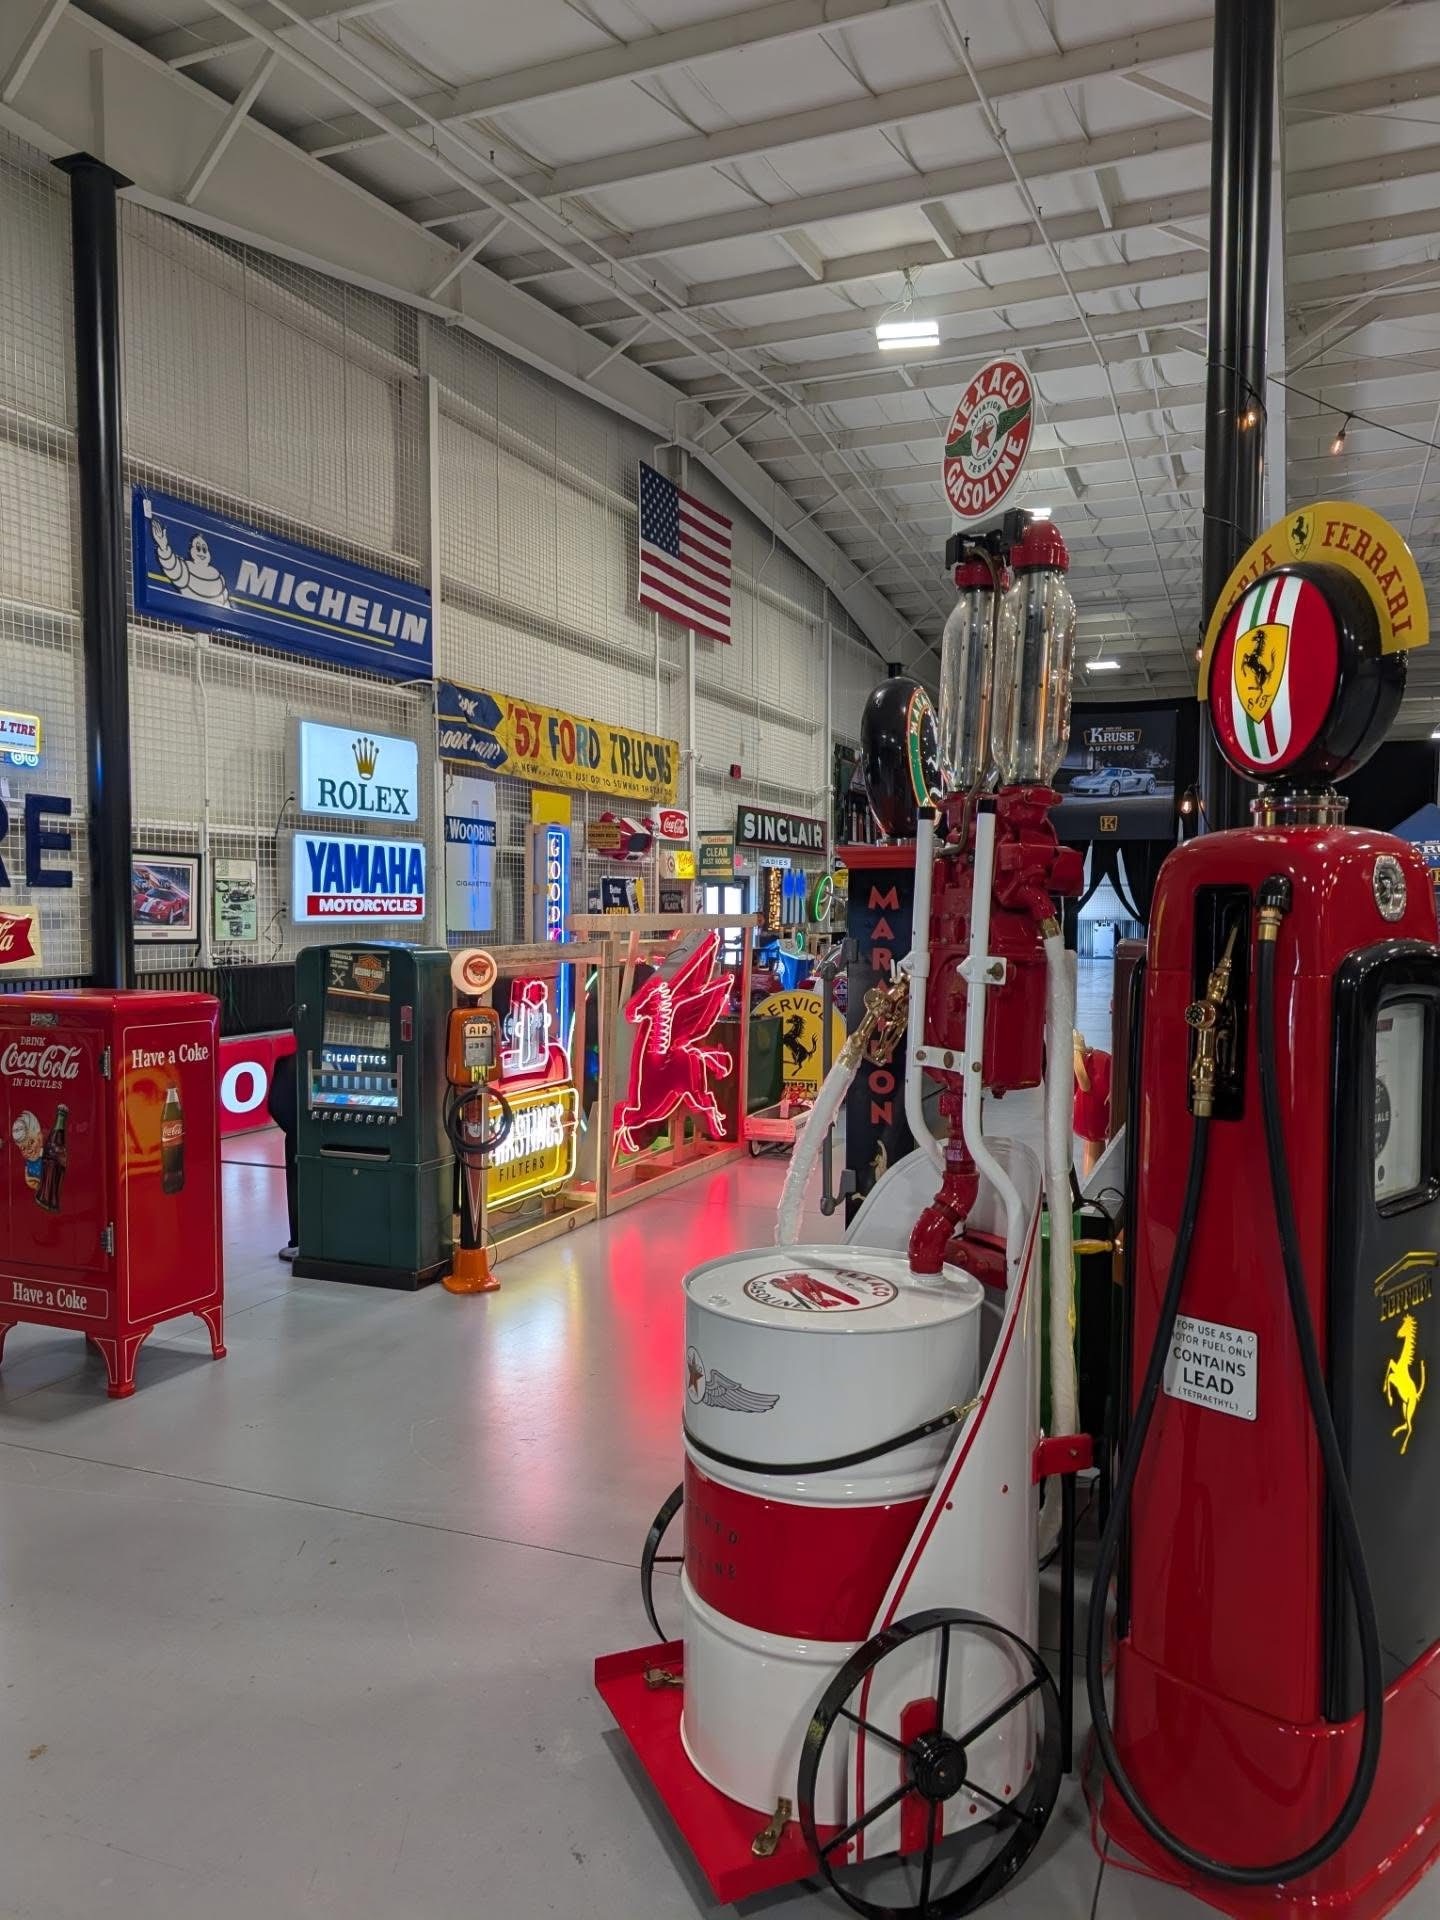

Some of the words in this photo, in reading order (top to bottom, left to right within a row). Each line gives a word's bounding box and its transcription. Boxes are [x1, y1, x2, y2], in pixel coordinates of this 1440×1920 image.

[951, 367, 1025, 435] TEXACO
[970, 401, 1003, 427] AVIATION
[946, 436, 1024, 510] GASOLINE
[968, 449, 999, 474] TESTED
[1321, 521, 1413, 637] FERRARI
[235, 560, 428, 645] MICHELIN
[9, 722, 36, 737] TIRE
[1089, 727, 1135, 743] KRUSE
[548, 716, 601, 770] FORD
[608, 732, 672, 785] TRUCKS
[318, 777, 410, 815] ROLEX
[448, 818, 495, 843] WOODBINE
[743, 813, 823, 848] SINCLAIR
[705, 848, 728, 857] CLEAN
[306, 840, 424, 894] YAMAHA
[319, 897, 418, 914] MOTORCYCLES
[20, 1036, 48, 1046] DRINK
[468, 1025, 489, 1035] AIR
[0, 1042, 83, 1079] Coca-Cola
[131, 1048, 165, 1069] Have
[168, 1050, 176, 1064] a
[179, 1042, 209, 1063] Coke
[326, 1053, 387, 1065] CIGARETTES
[12, 1077, 23, 1087] IN
[24, 1079, 63, 1090] BOTTLES
[499, 1155, 546, 1183] FILTERS
[13, 1281, 43, 1304] Have
[46, 1291, 54, 1306] a
[56, 1288, 87, 1310] Coke
[836, 1270, 890, 1298] TEXACO
[1177, 1320, 1195, 1332] FOR
[1198, 1325, 1216, 1338] USE
[1220, 1331, 1232, 1341] AS
[1236, 1335, 1243, 1344] A
[1173, 1347, 1246, 1377] CONTAINS
[1202, 1339, 1226, 1353] FUEL
[1228, 1346, 1253, 1359] ONLY
[1183, 1367, 1234, 1395] LEAD
